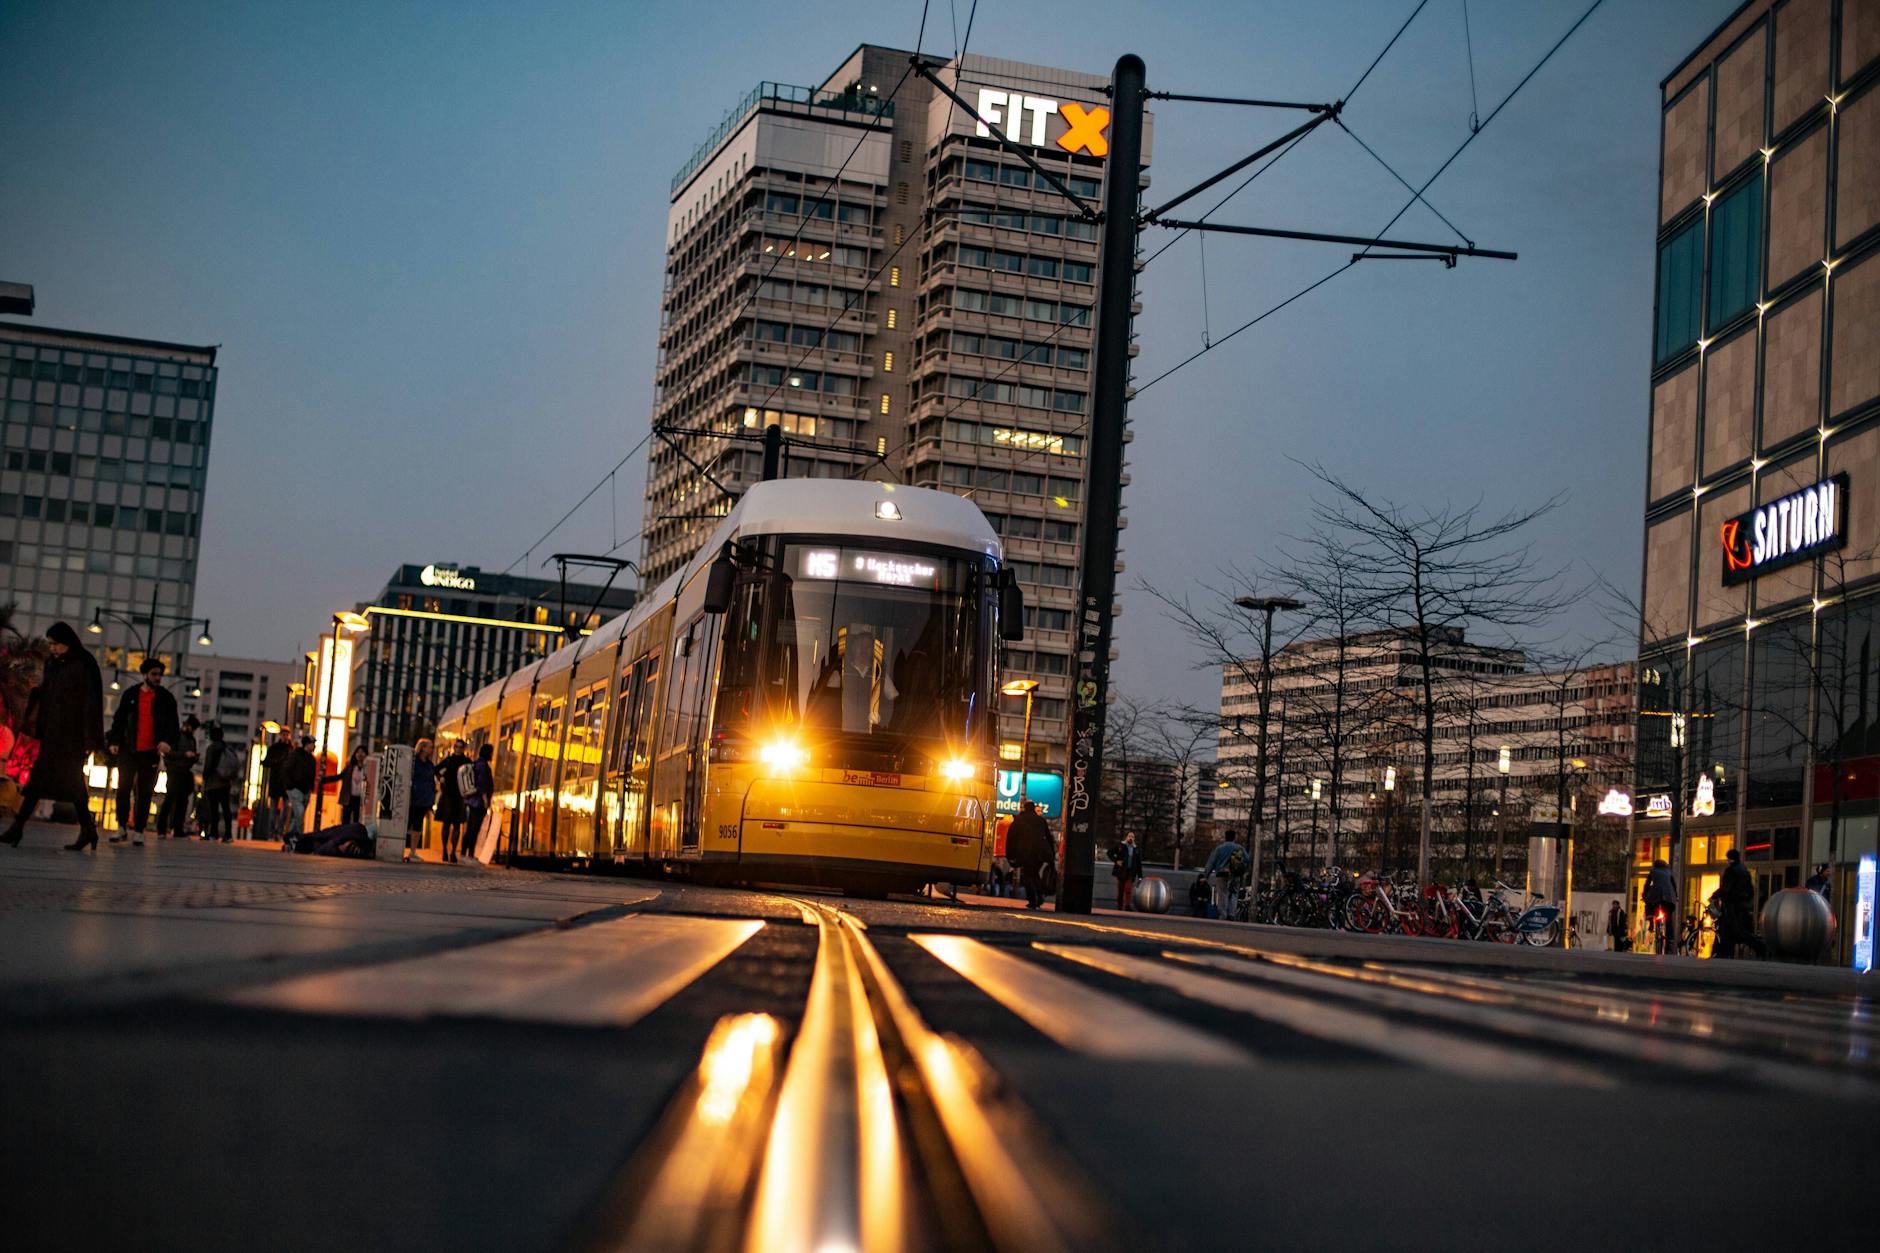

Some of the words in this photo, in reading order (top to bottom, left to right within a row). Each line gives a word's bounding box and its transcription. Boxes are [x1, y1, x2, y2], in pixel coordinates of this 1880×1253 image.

[1754, 481, 1835, 566] SATURN
[807, 552, 837, 577] M5
[999, 771, 1021, 797] U
[719, 824, 738, 839] 9056
